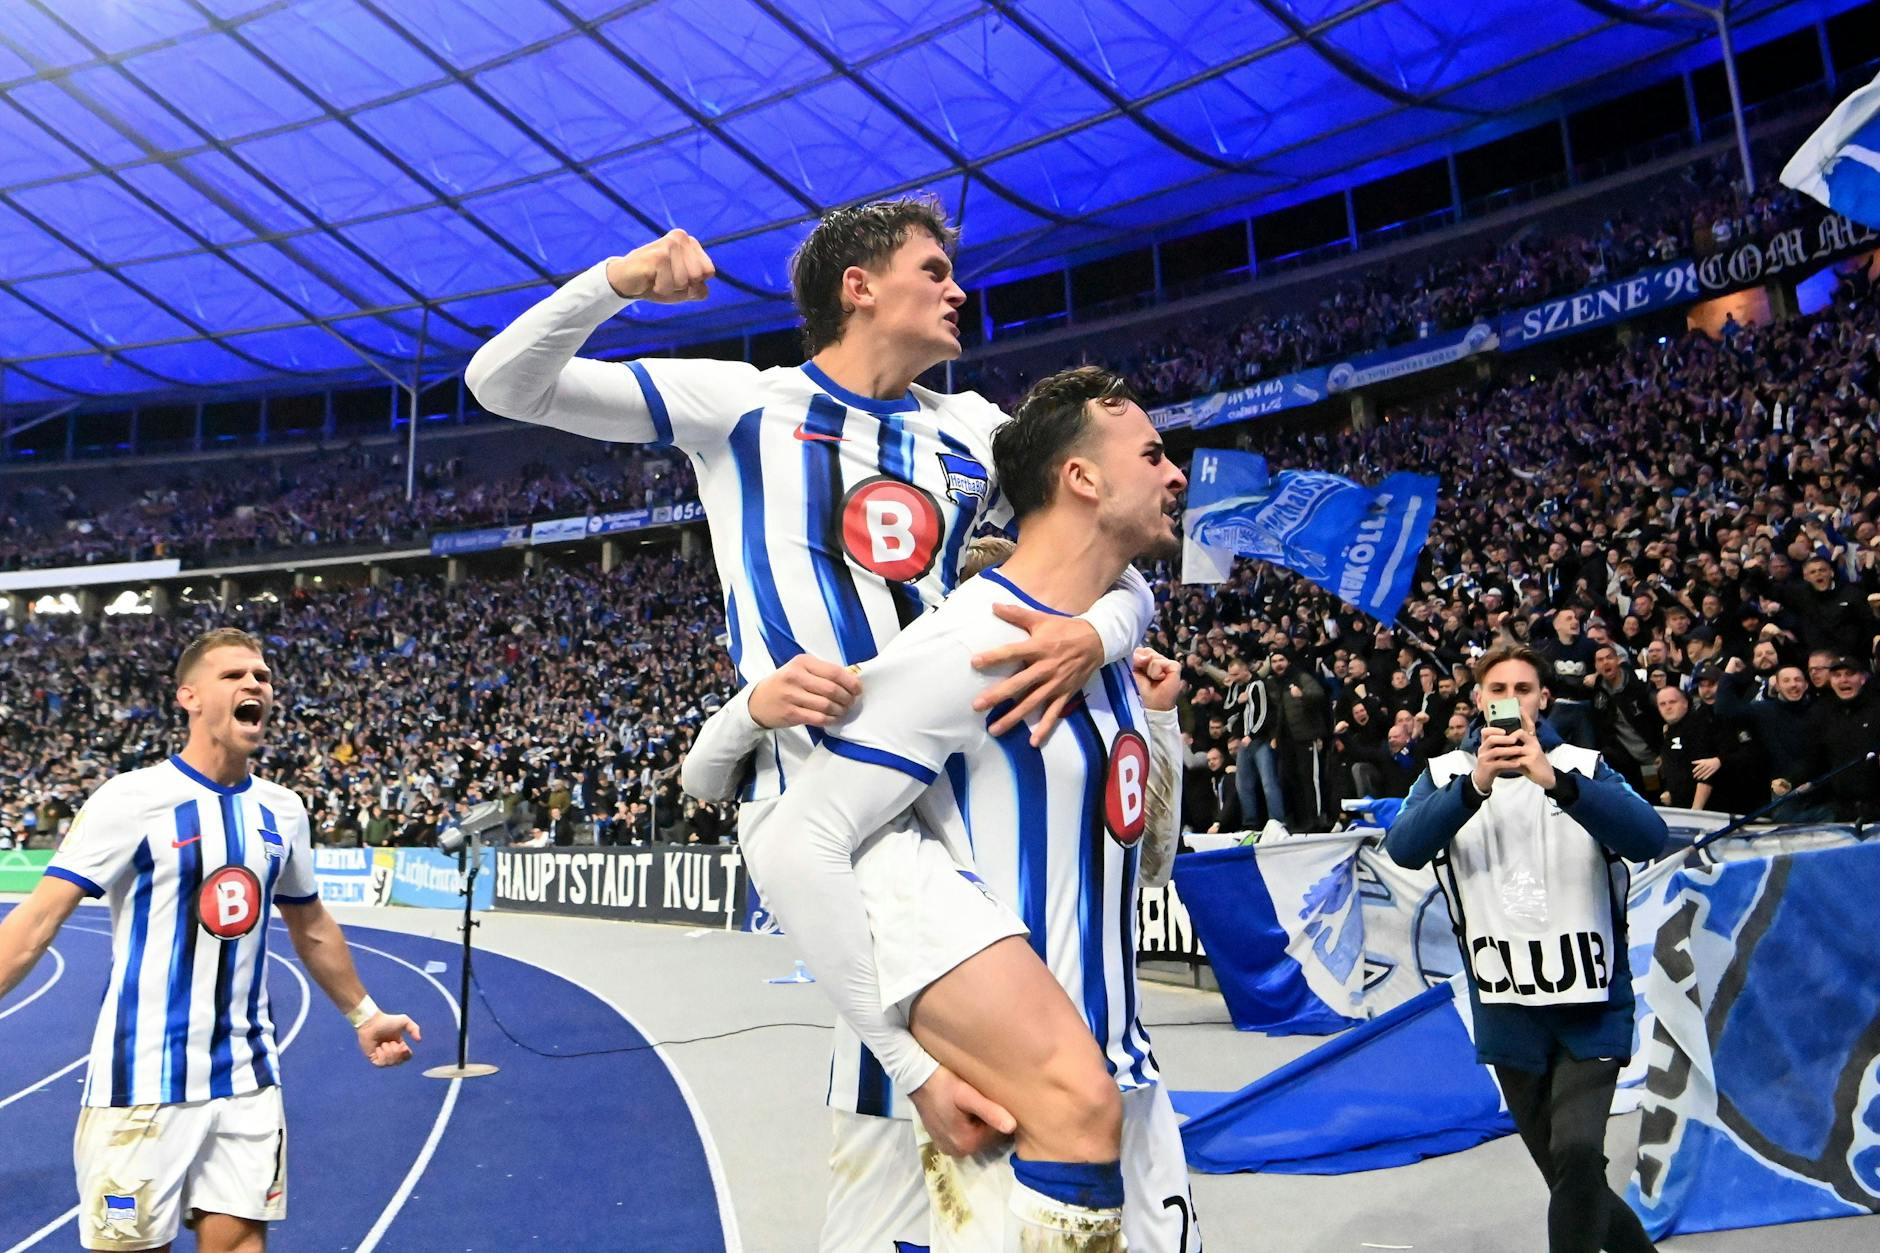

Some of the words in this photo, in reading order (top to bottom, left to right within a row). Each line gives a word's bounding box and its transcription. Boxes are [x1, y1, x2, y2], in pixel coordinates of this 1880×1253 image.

[1522, 277, 1650, 340] SZENE
[866, 500, 916, 563] B
[1118, 755, 1142, 828] B
[216, 881, 249, 927] B
[496, 851, 653, 908] HAUPTSTADT
[662, 851, 742, 913] KULT
[1472, 931, 1608, 996] CLUB
